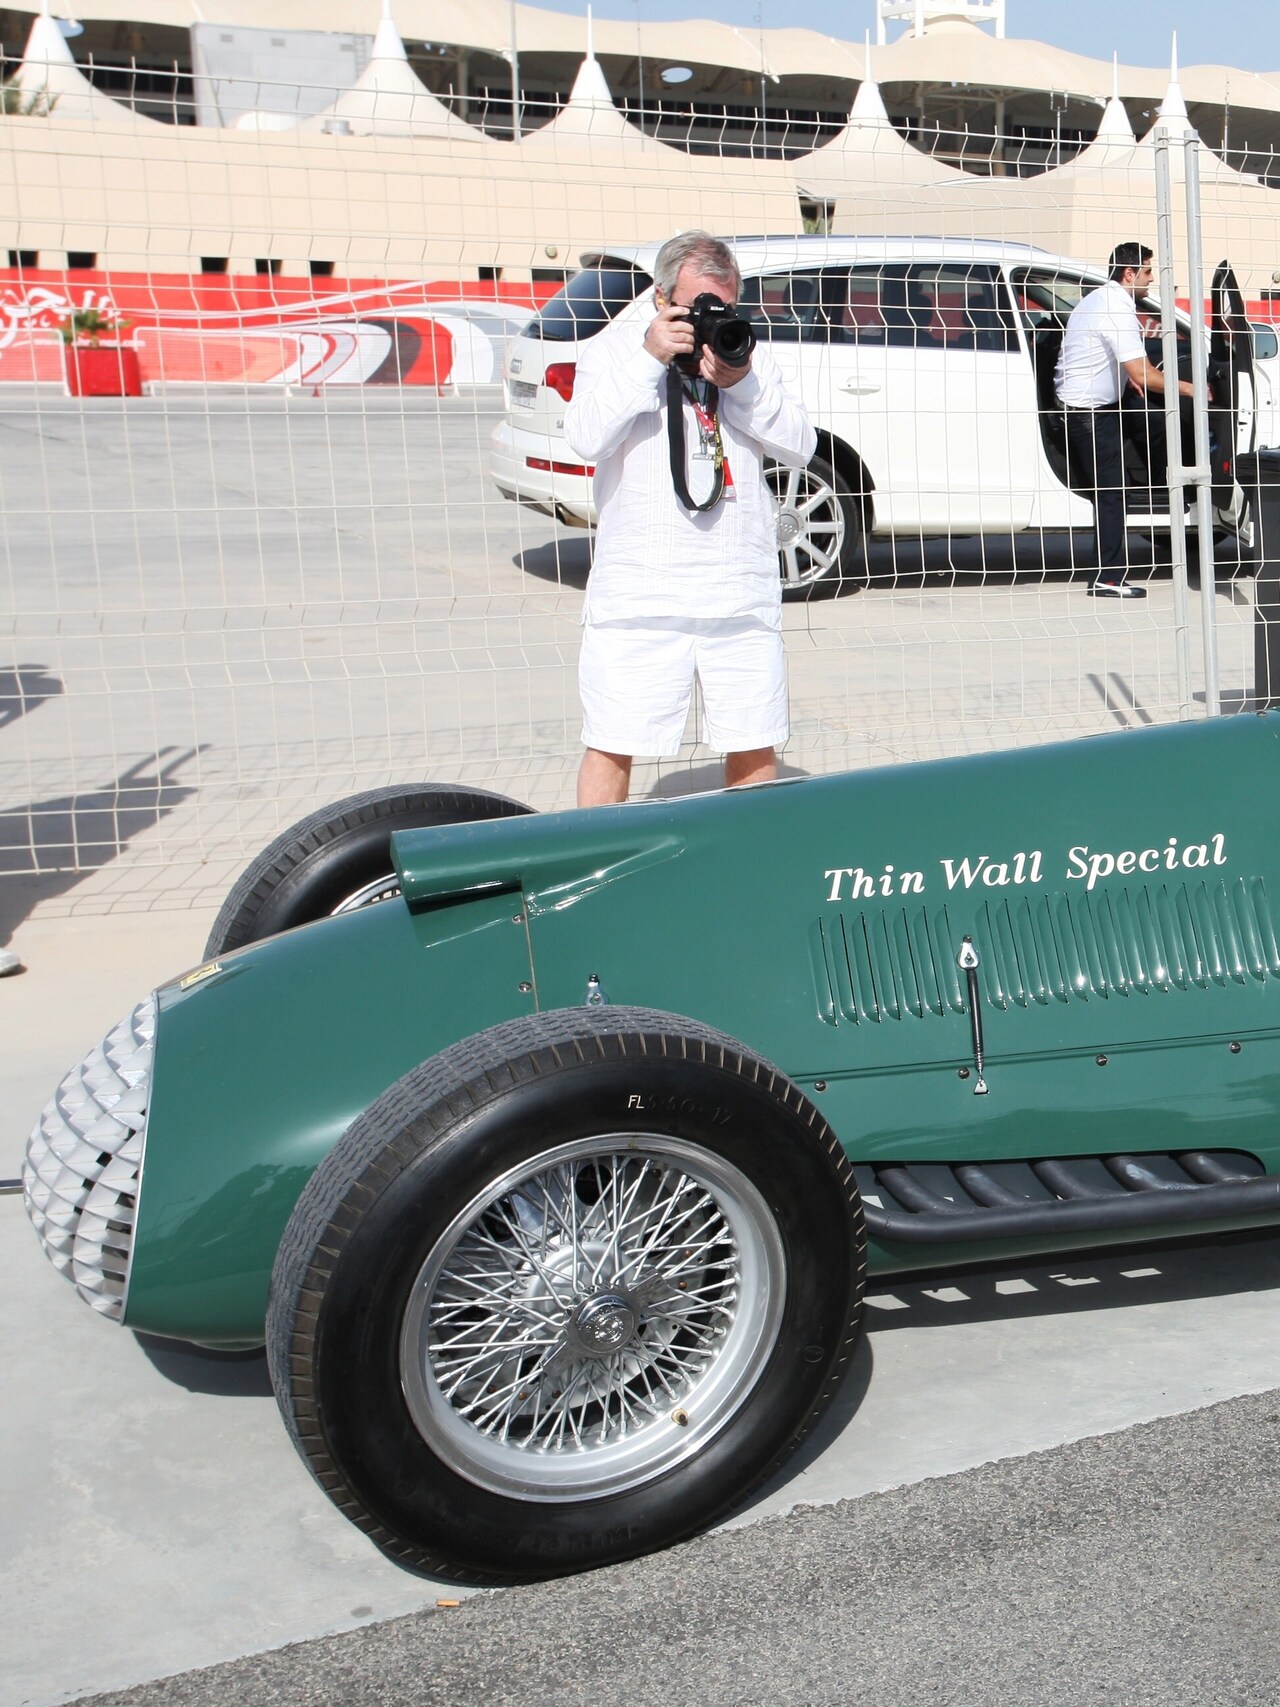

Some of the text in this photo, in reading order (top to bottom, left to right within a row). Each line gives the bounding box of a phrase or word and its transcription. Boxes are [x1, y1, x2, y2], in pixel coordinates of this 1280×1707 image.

[823, 833, 1229, 902] Thin Wall Special
